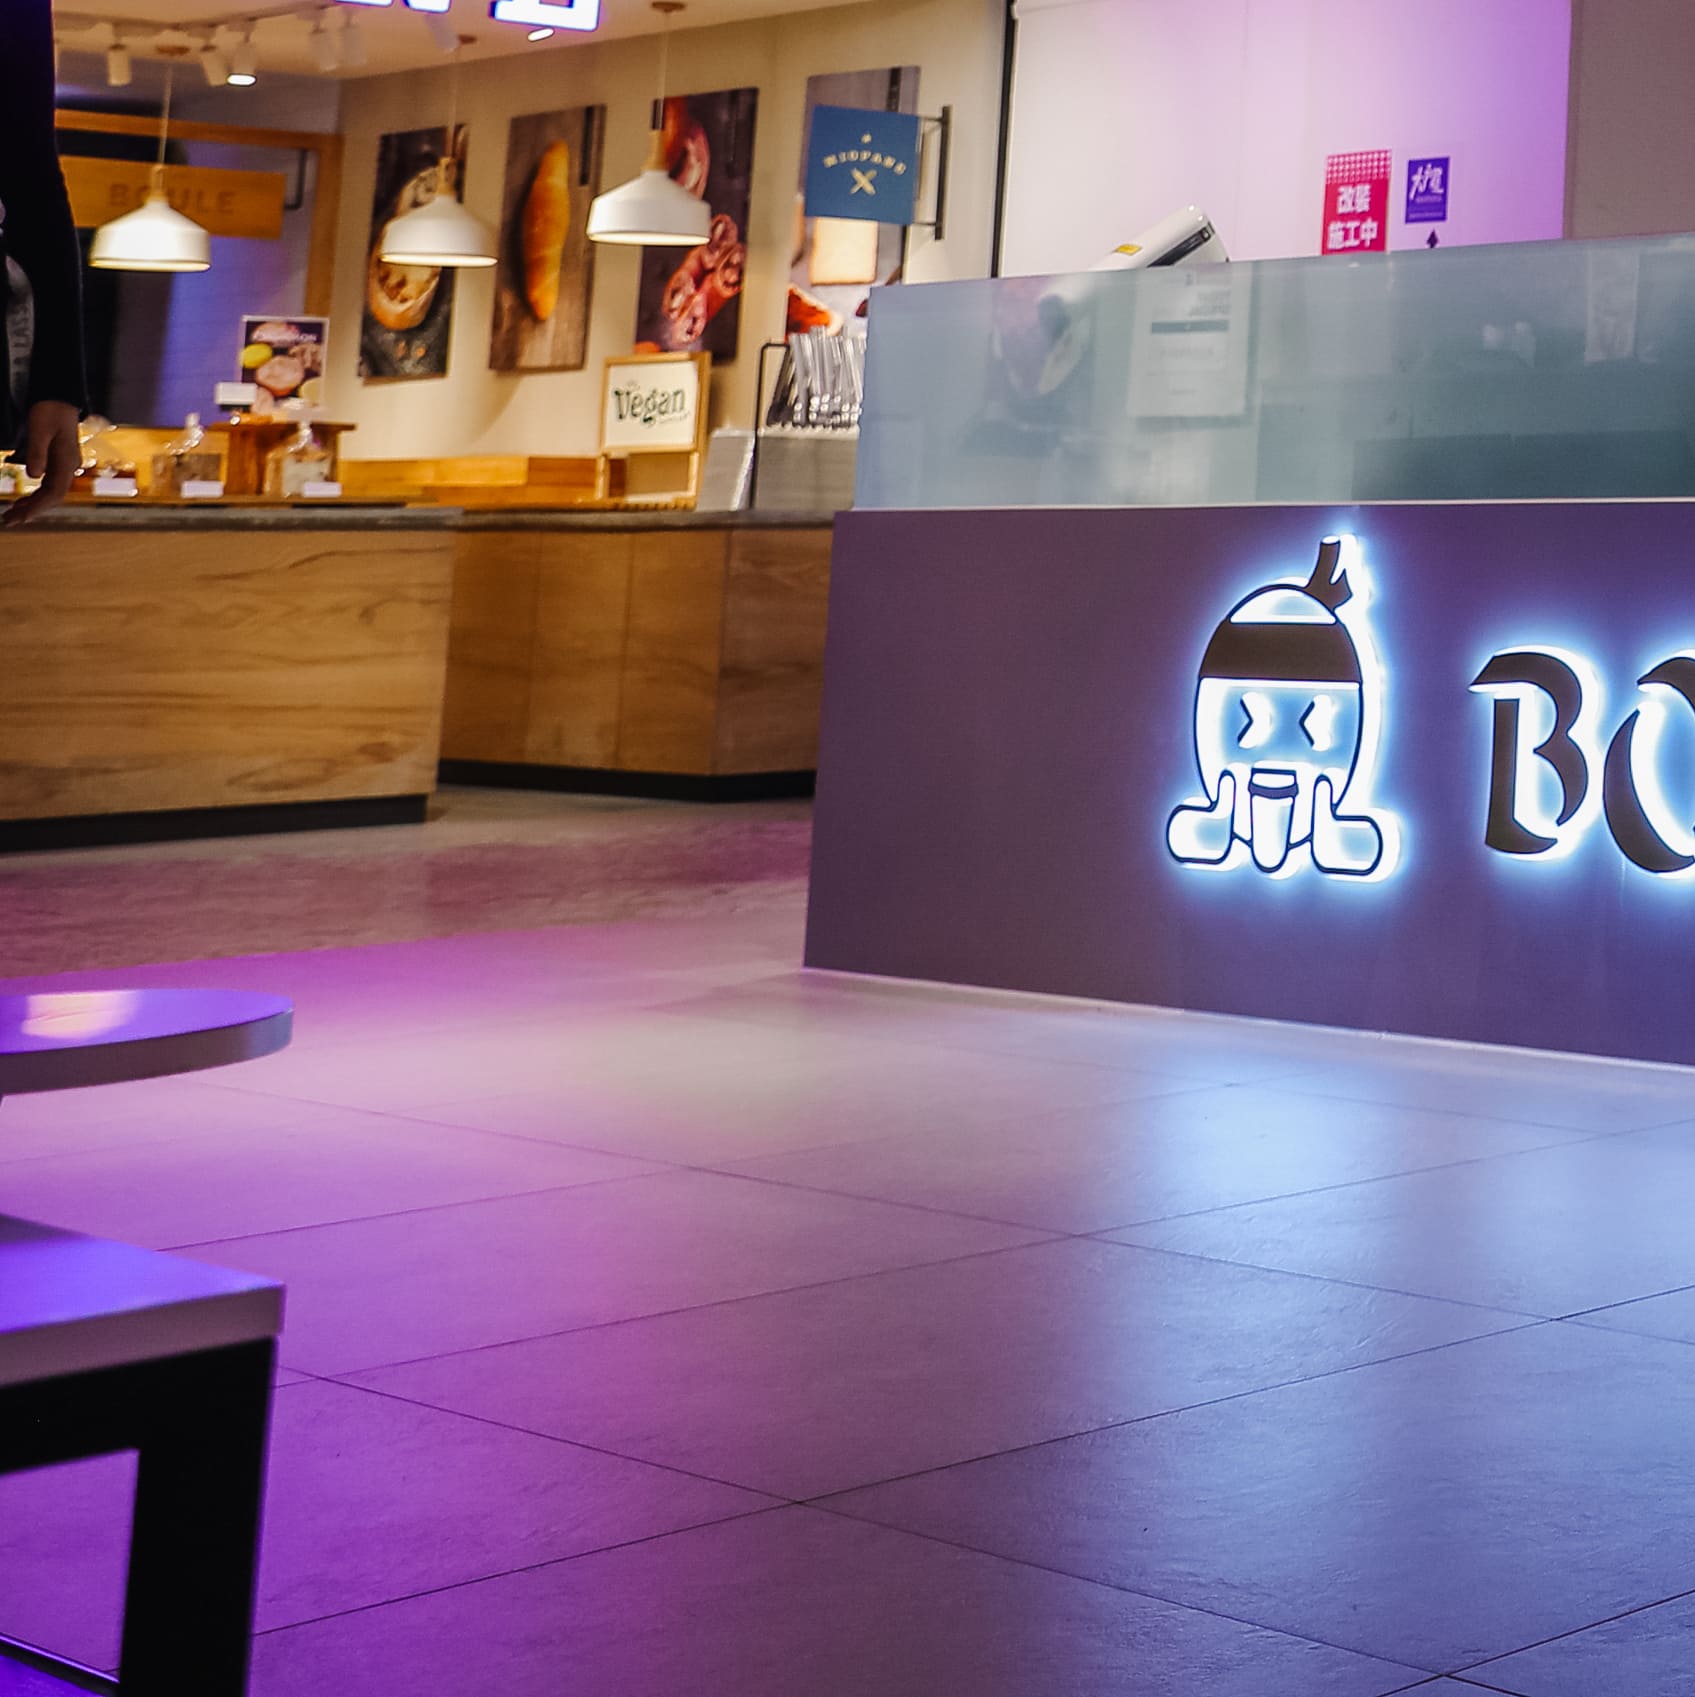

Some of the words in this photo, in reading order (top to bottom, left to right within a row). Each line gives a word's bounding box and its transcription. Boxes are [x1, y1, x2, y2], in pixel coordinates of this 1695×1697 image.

[1327, 217, 1378, 251] 施工中
[614, 387, 685, 428] Vegan
